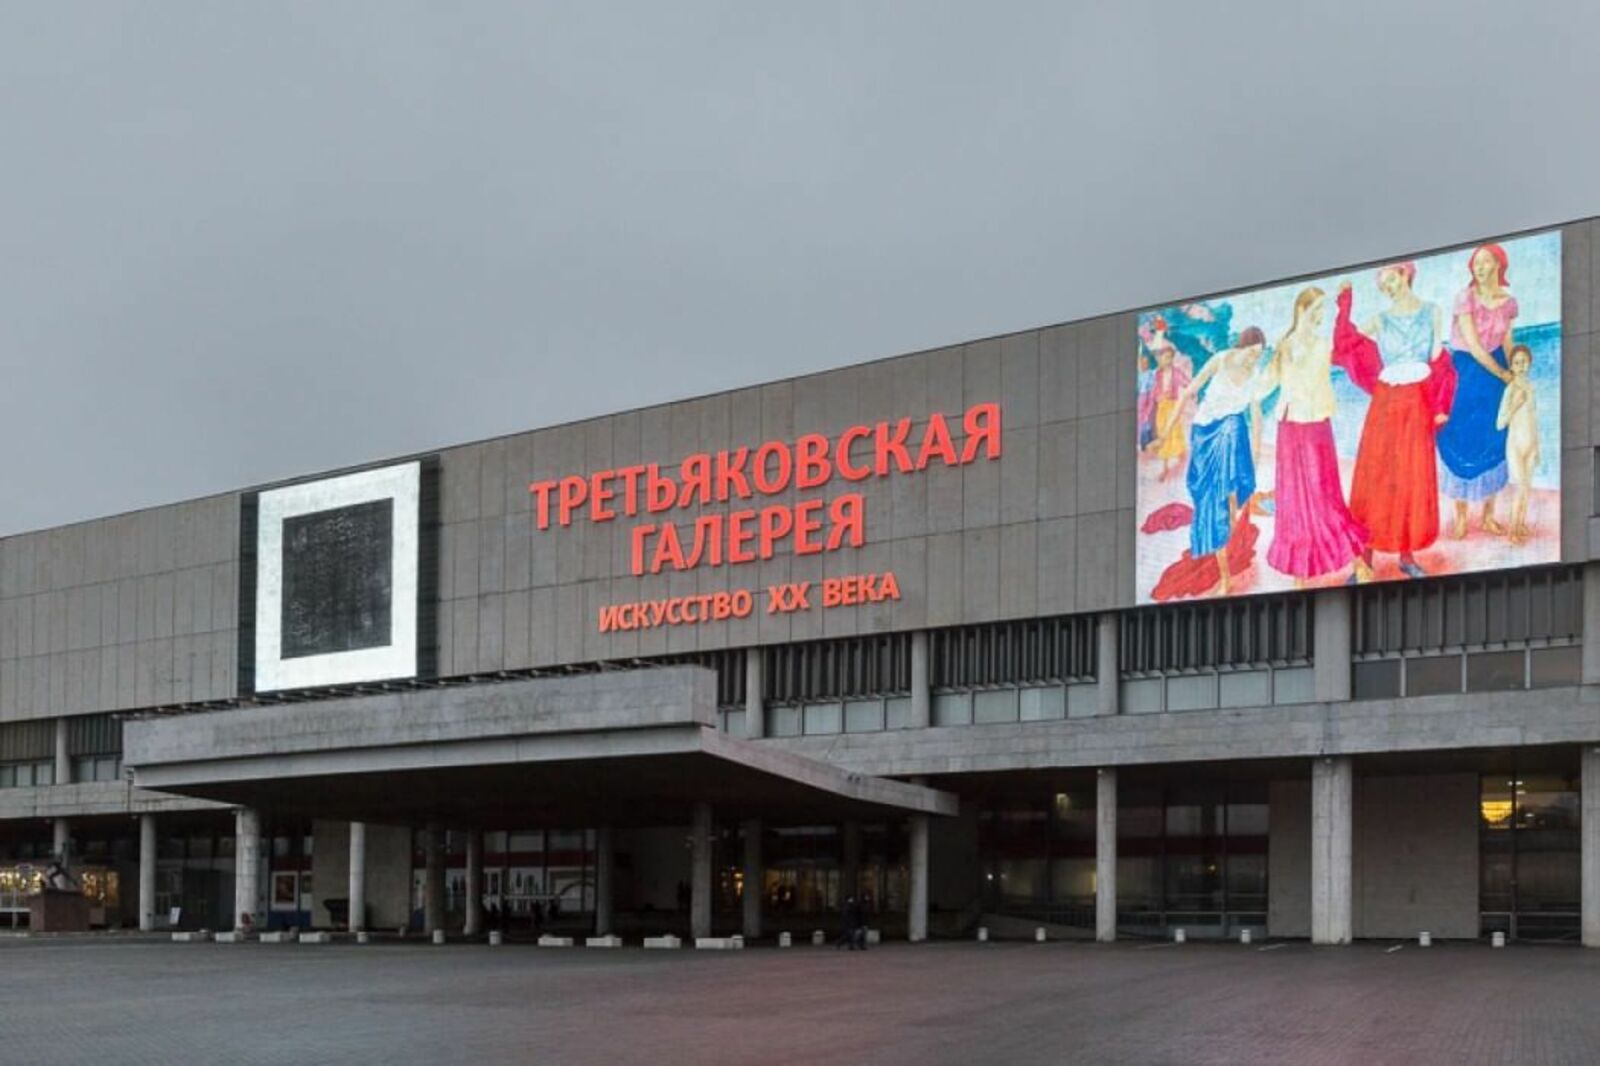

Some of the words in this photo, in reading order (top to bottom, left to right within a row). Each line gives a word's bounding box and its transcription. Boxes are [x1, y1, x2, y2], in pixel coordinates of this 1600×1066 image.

[529, 402, 1003, 531] ТРЕТЬЯКОВСКАЯ
[631, 493, 865, 576] ГАЛЕРЕЯ
[599, 590, 753, 633] ИСКУССТВО
[822, 572, 901, 609] ВЕКА
